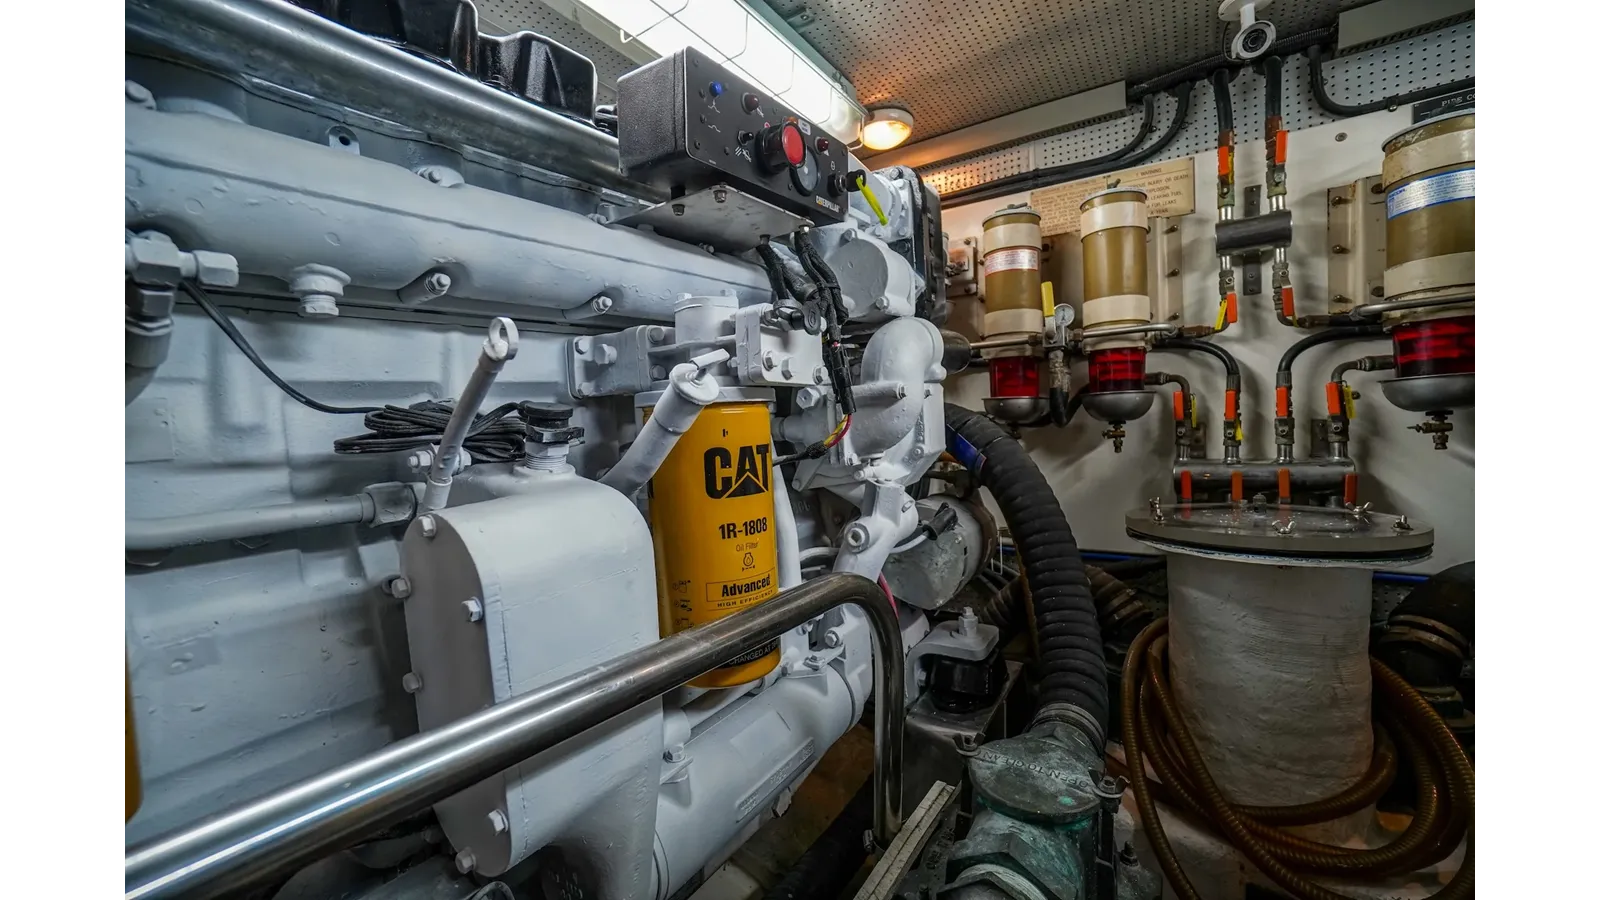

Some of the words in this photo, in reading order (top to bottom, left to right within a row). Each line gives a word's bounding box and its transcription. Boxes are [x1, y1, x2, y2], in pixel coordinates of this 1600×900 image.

[704, 443, 769, 499] CAT
[718, 517, 768, 539] 1R-1808
[736, 543, 744, 552] Oil
[745, 541, 759, 551] Filter
[721, 574, 771, 598] Advanced
[717, 600, 737, 608] HIGH
[739, 589, 773, 605] EFFICIENCY
[983, 751, 1024, 768] CLEAN
[1027, 763, 1045, 774] TO
[1048, 769, 1089, 788] OPEN
